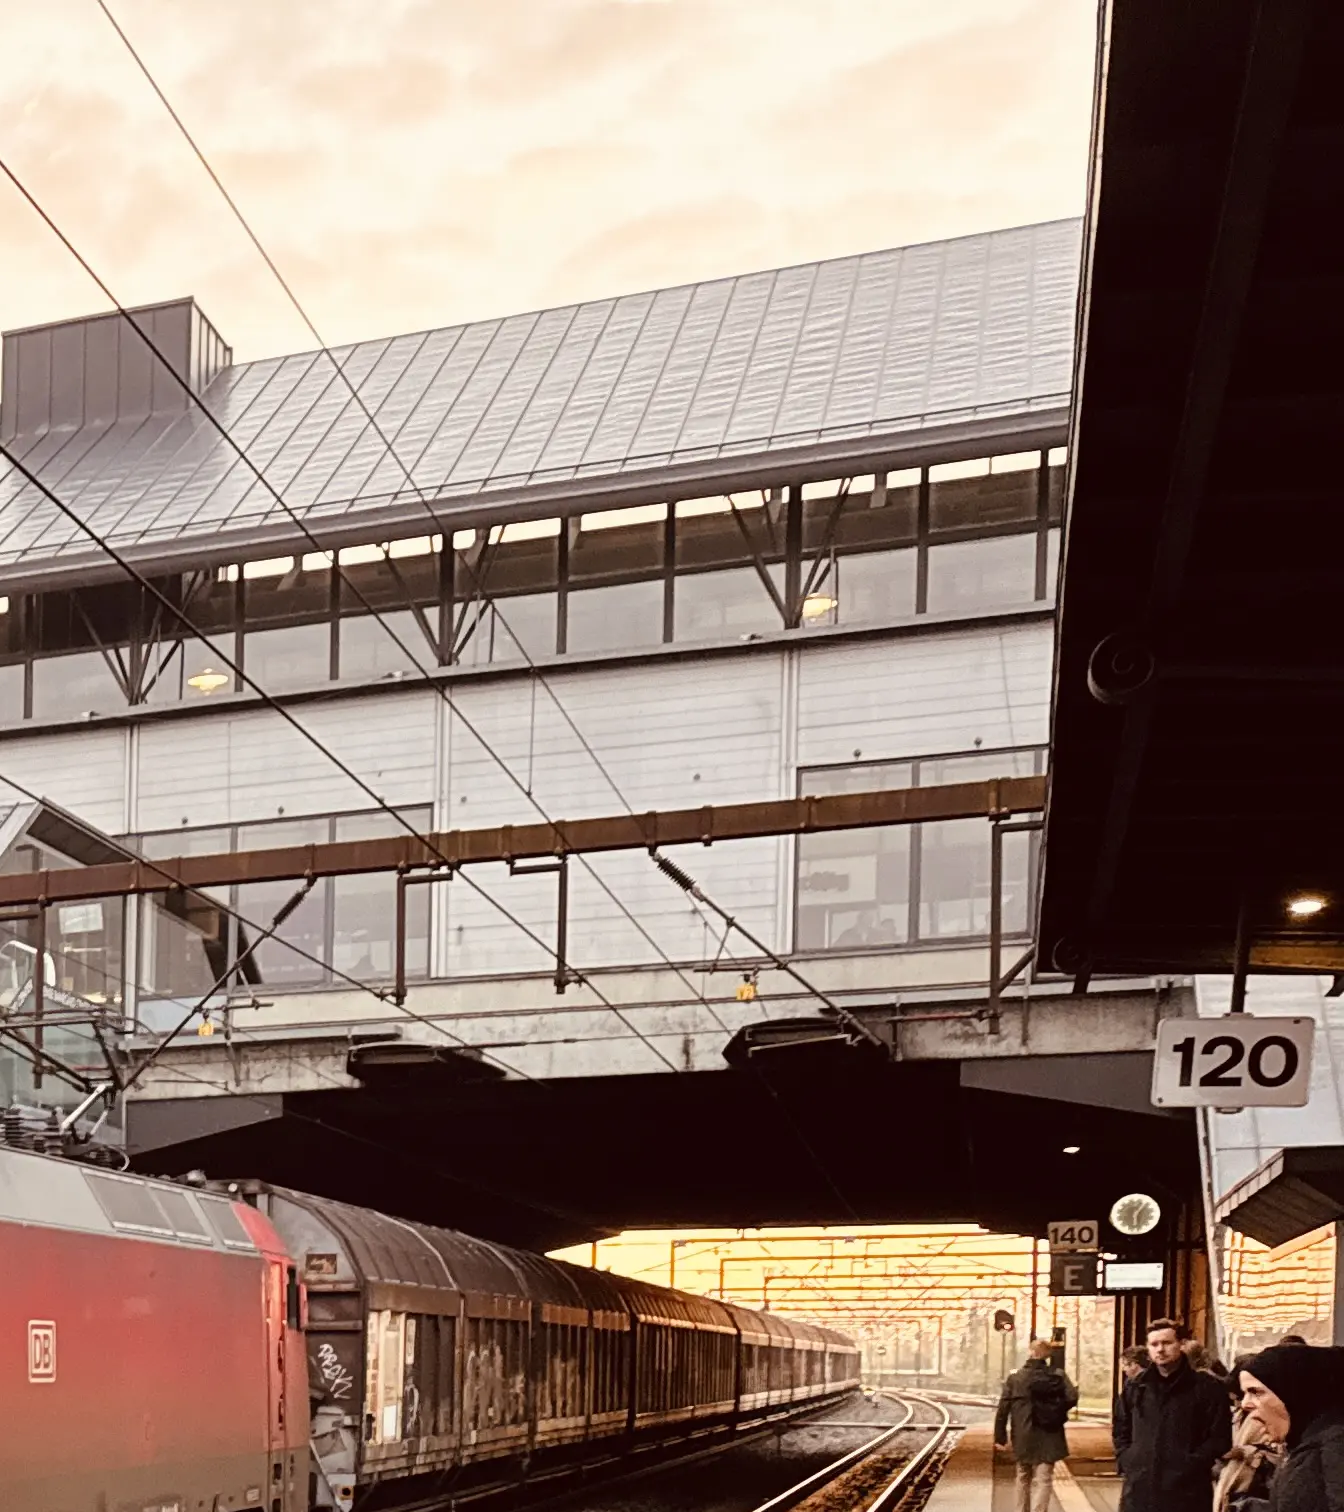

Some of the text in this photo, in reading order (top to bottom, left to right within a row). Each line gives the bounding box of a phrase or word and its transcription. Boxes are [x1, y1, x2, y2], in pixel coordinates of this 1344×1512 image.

[1172, 1036, 1299, 1087] 120
[1050, 1226, 1094, 1244] 140
[1064, 1265, 1084, 1290] E
[33, 1333, 52, 1370] DB
